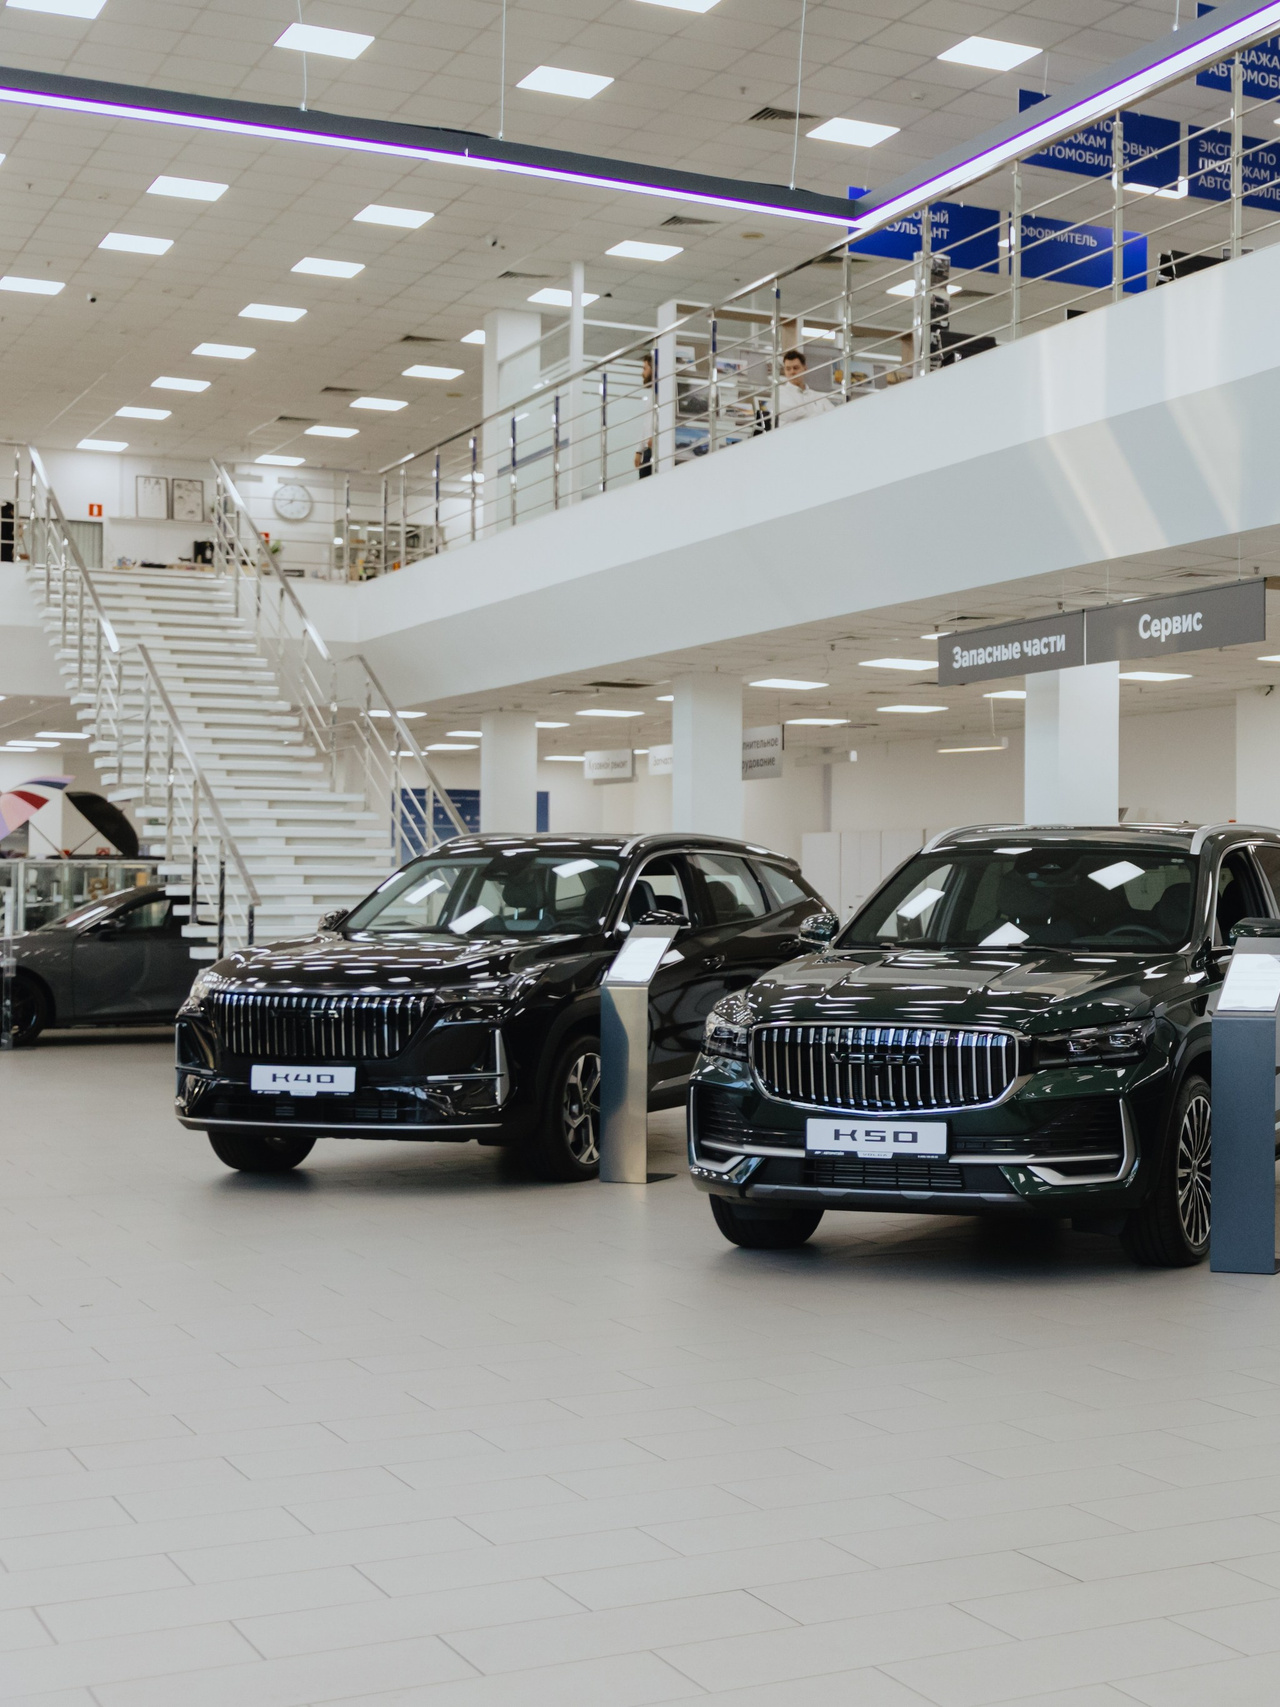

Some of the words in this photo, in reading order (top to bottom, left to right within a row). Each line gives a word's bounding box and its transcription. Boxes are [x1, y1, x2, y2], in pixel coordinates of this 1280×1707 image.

[1258, 150, 1277, 166] ПО
[1138, 611, 1203, 643] Сервис
[952, 640, 1021, 669] Запасные
[1023, 634, 1066, 656] части
[272, 1073, 334, 1084] K40
[834, 1129, 918, 1143] K50
